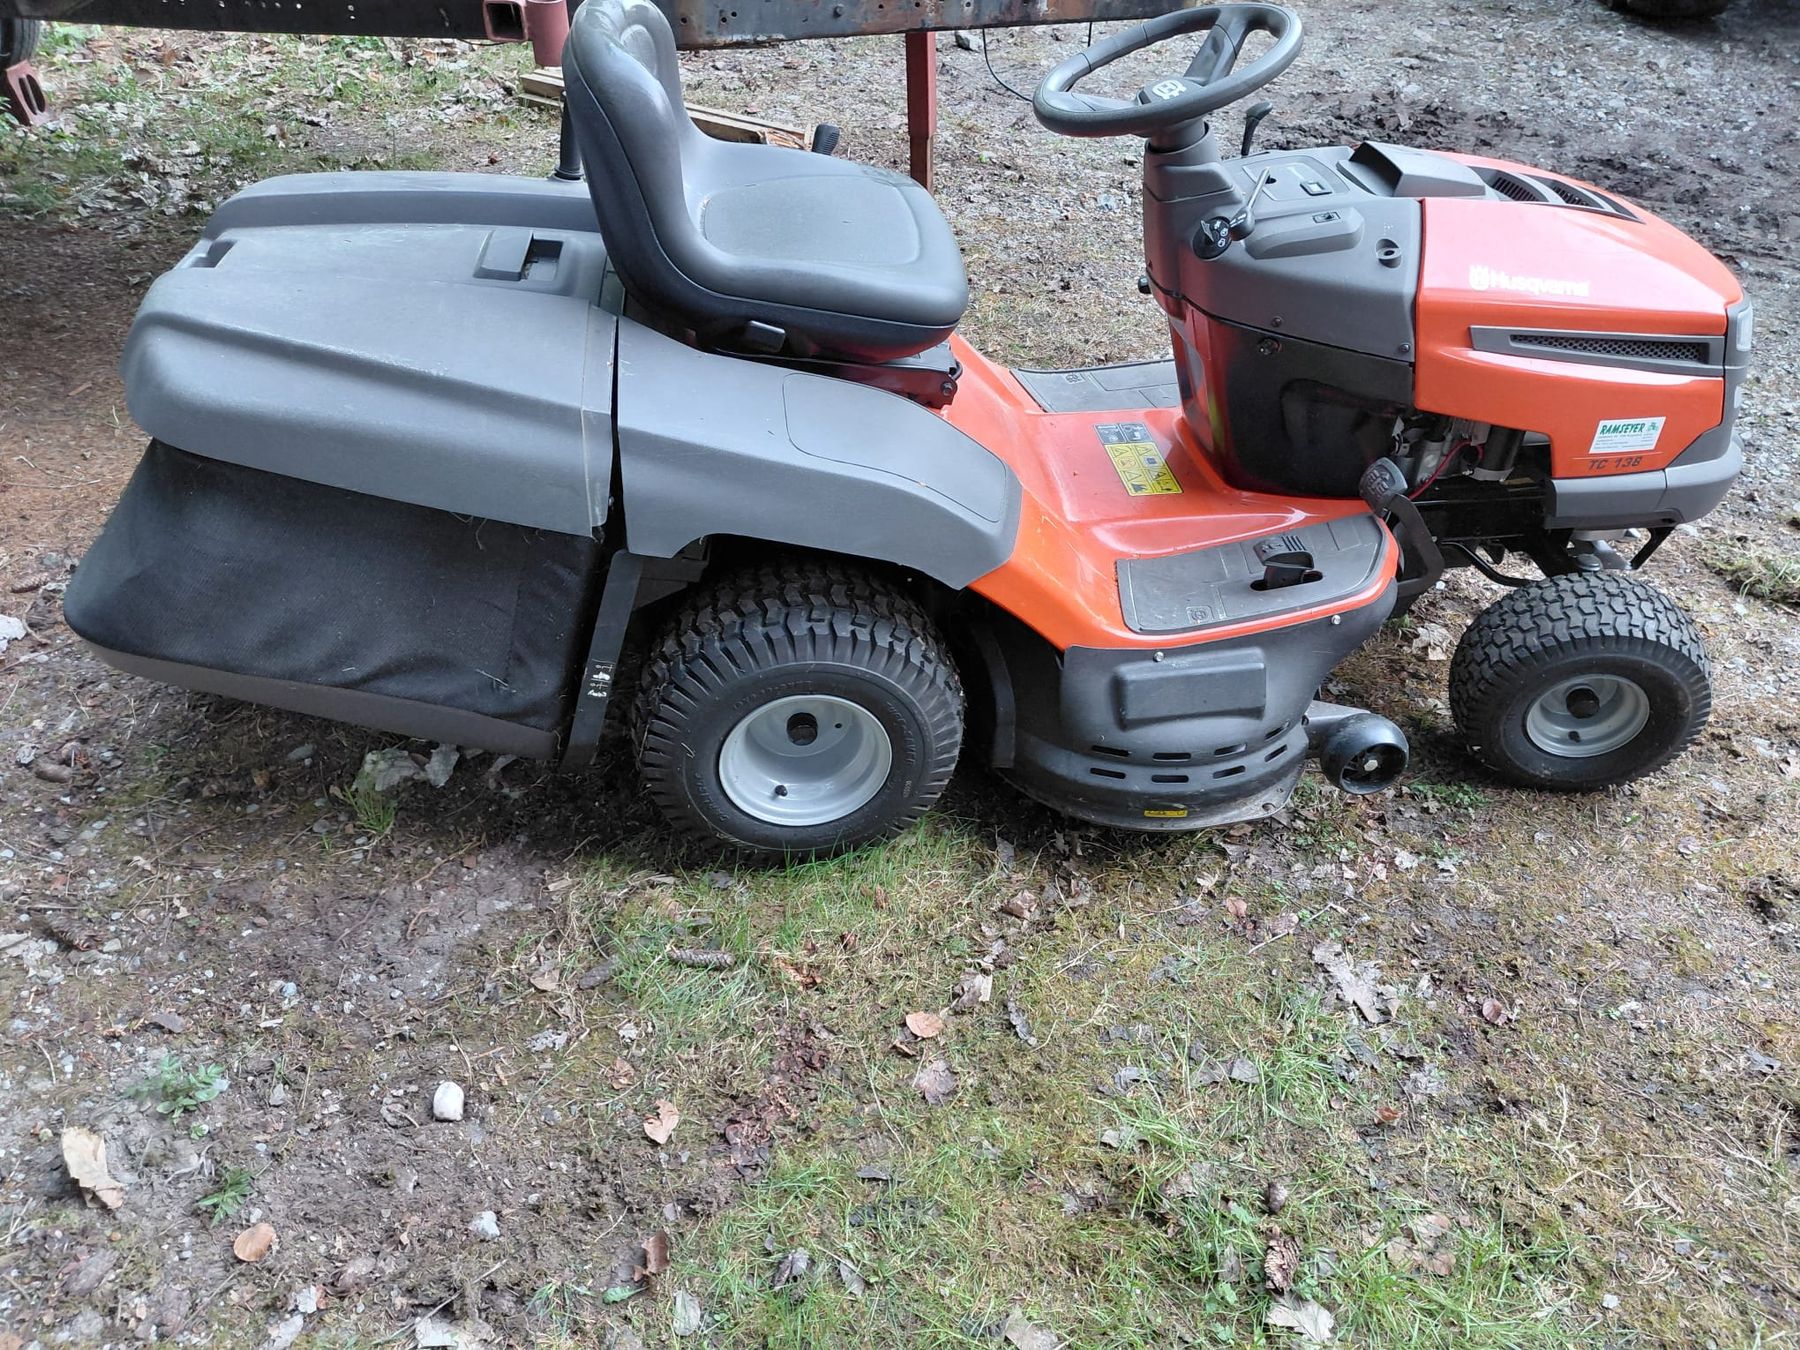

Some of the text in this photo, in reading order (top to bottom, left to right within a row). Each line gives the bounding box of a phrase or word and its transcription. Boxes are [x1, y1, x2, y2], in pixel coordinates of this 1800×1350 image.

[1599, 422, 1646, 435] RAMSEYER
[1588, 456, 1643, 470] TC 138
